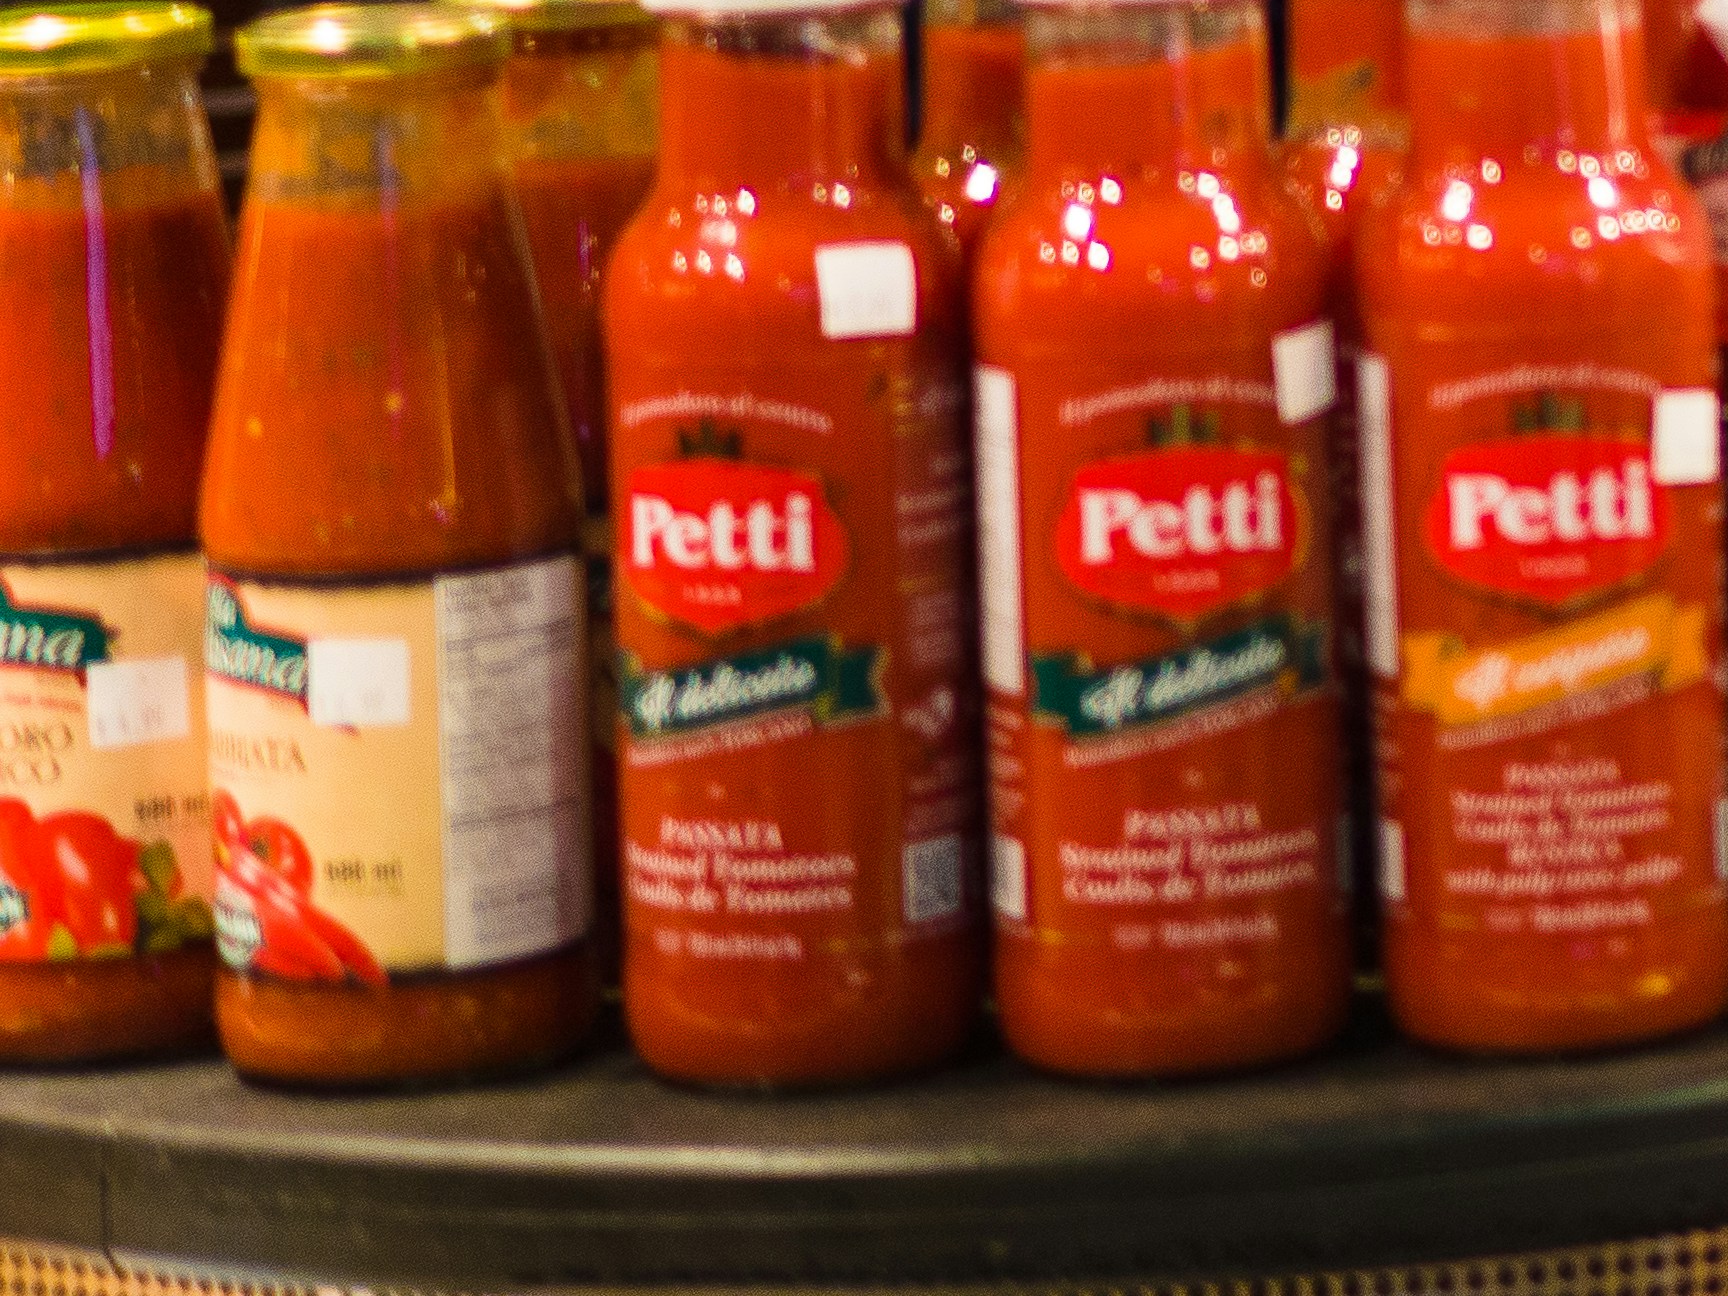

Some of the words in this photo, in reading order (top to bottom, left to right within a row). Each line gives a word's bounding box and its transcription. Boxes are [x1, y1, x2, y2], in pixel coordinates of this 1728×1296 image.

[631, 490, 816, 572] Petti
[1078, 472, 1285, 566] Petti
[1444, 456, 1654, 551] Petti
